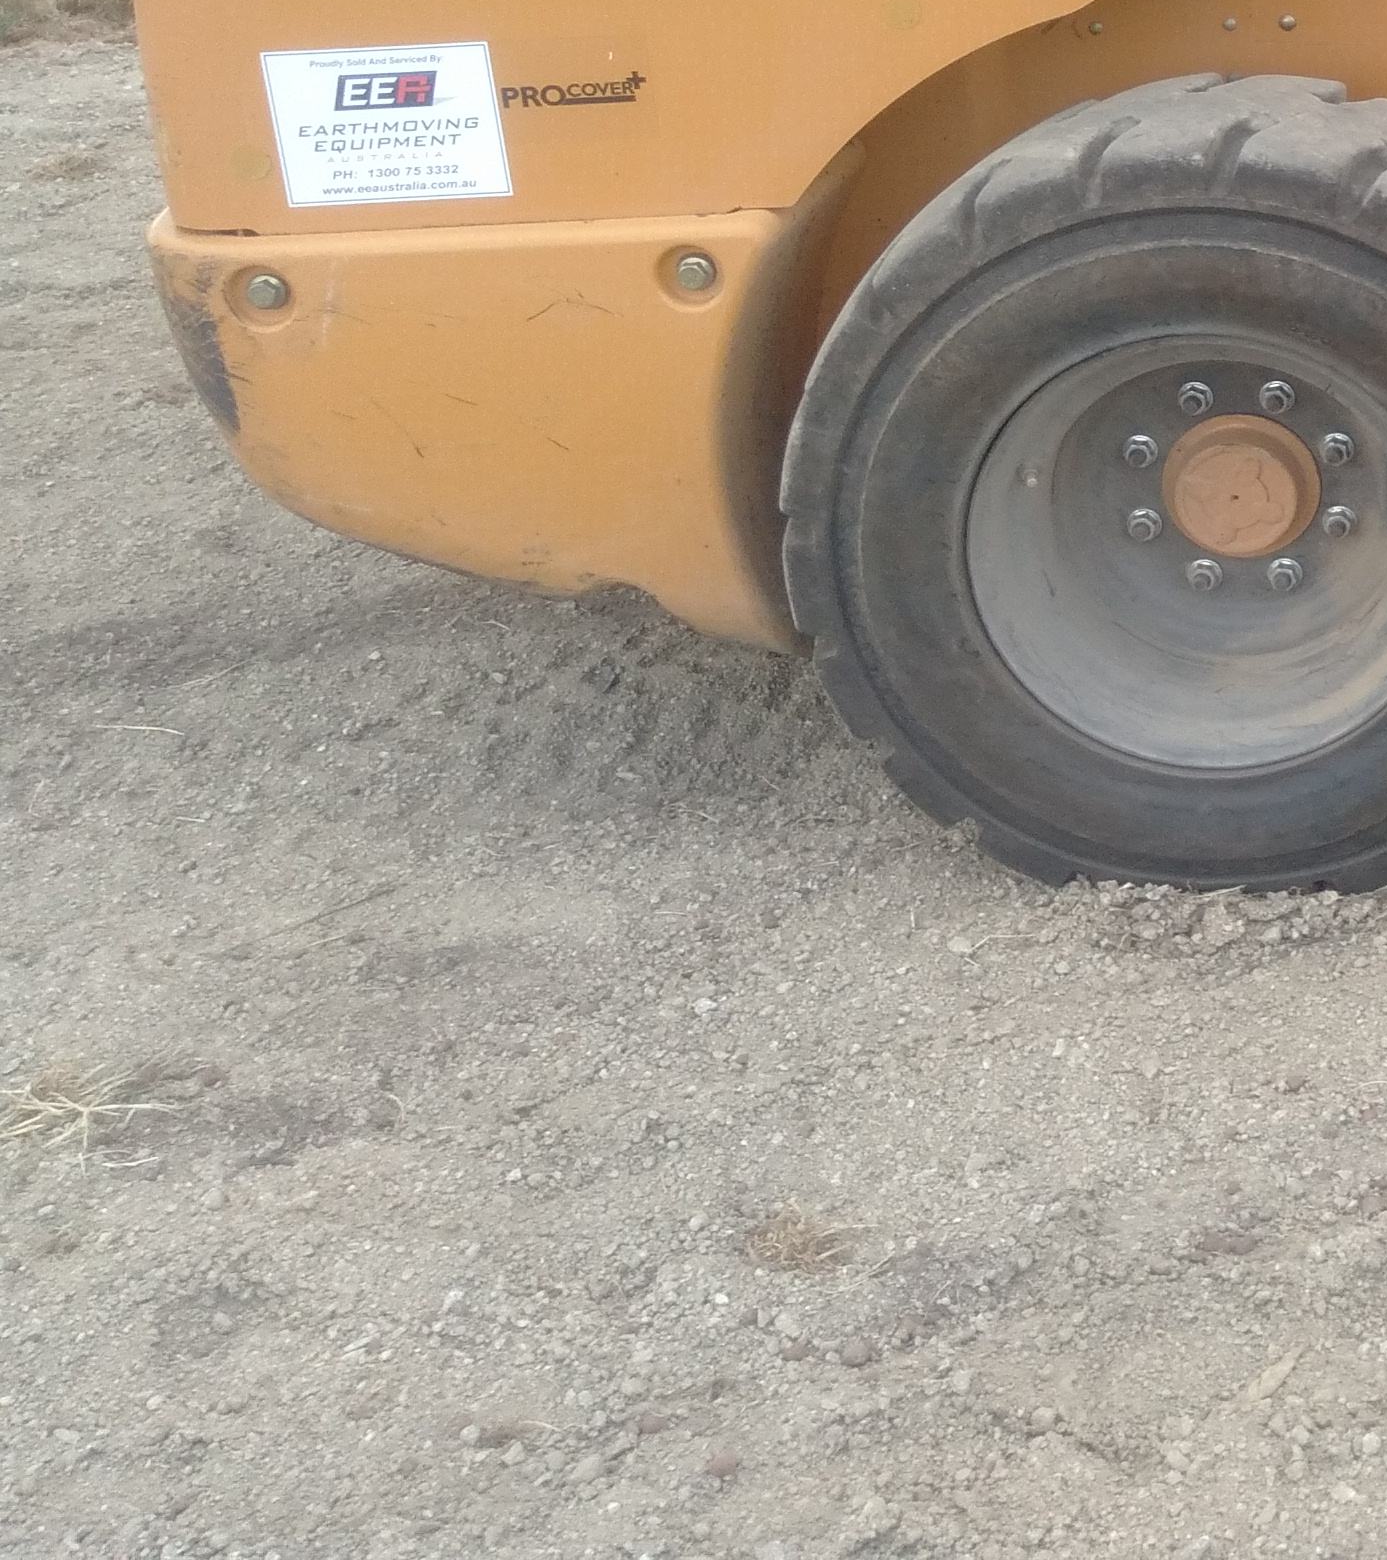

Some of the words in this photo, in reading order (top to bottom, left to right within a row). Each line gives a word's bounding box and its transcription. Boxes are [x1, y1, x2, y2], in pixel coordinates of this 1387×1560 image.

[309, 60, 343, 69] Proudly
[346, 58, 366, 67] Sold
[369, 57, 387, 65] And
[389, 55, 428, 64] Serviced
[298, 117, 479, 138] EARTHMOVING
[314, 134, 462, 153] EQUIPMENT
[327, 151, 443, 163] AUSTRALIA
[332, 170, 358, 180] PH:
[367, 167, 401, 178] 1300
[405, 166, 422, 176] 75
[426, 164, 459, 175] 3332
[322, 180, 477, 195] www.eeaustralia.com.au
